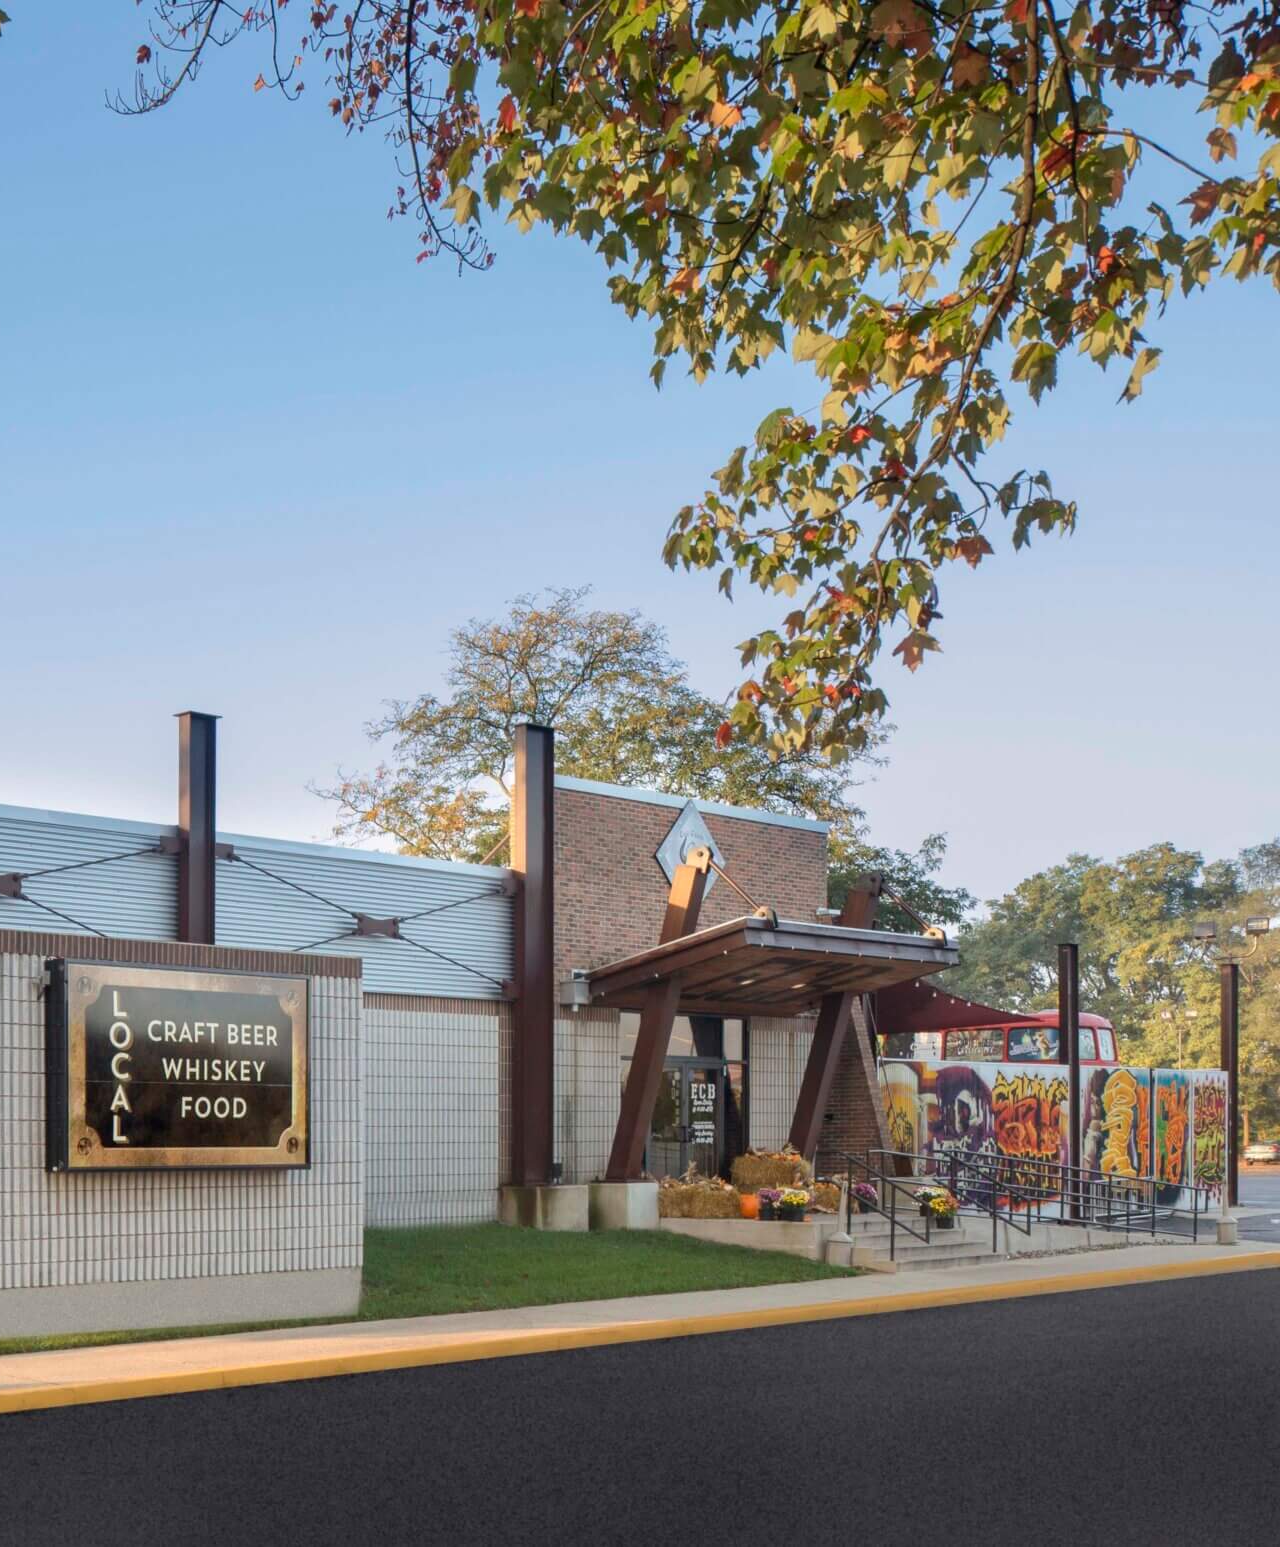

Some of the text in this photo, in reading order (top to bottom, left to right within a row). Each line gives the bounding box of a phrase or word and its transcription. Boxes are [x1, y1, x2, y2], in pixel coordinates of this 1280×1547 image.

[147, 1020, 278, 1046] CRAFT BEER
[109, 990, 133, 1144] LOCAL
[162, 1058, 266, 1082] WHISKEY
[691, 1083, 716, 1099] ECB
[181, 1097, 247, 1119] FOOD
